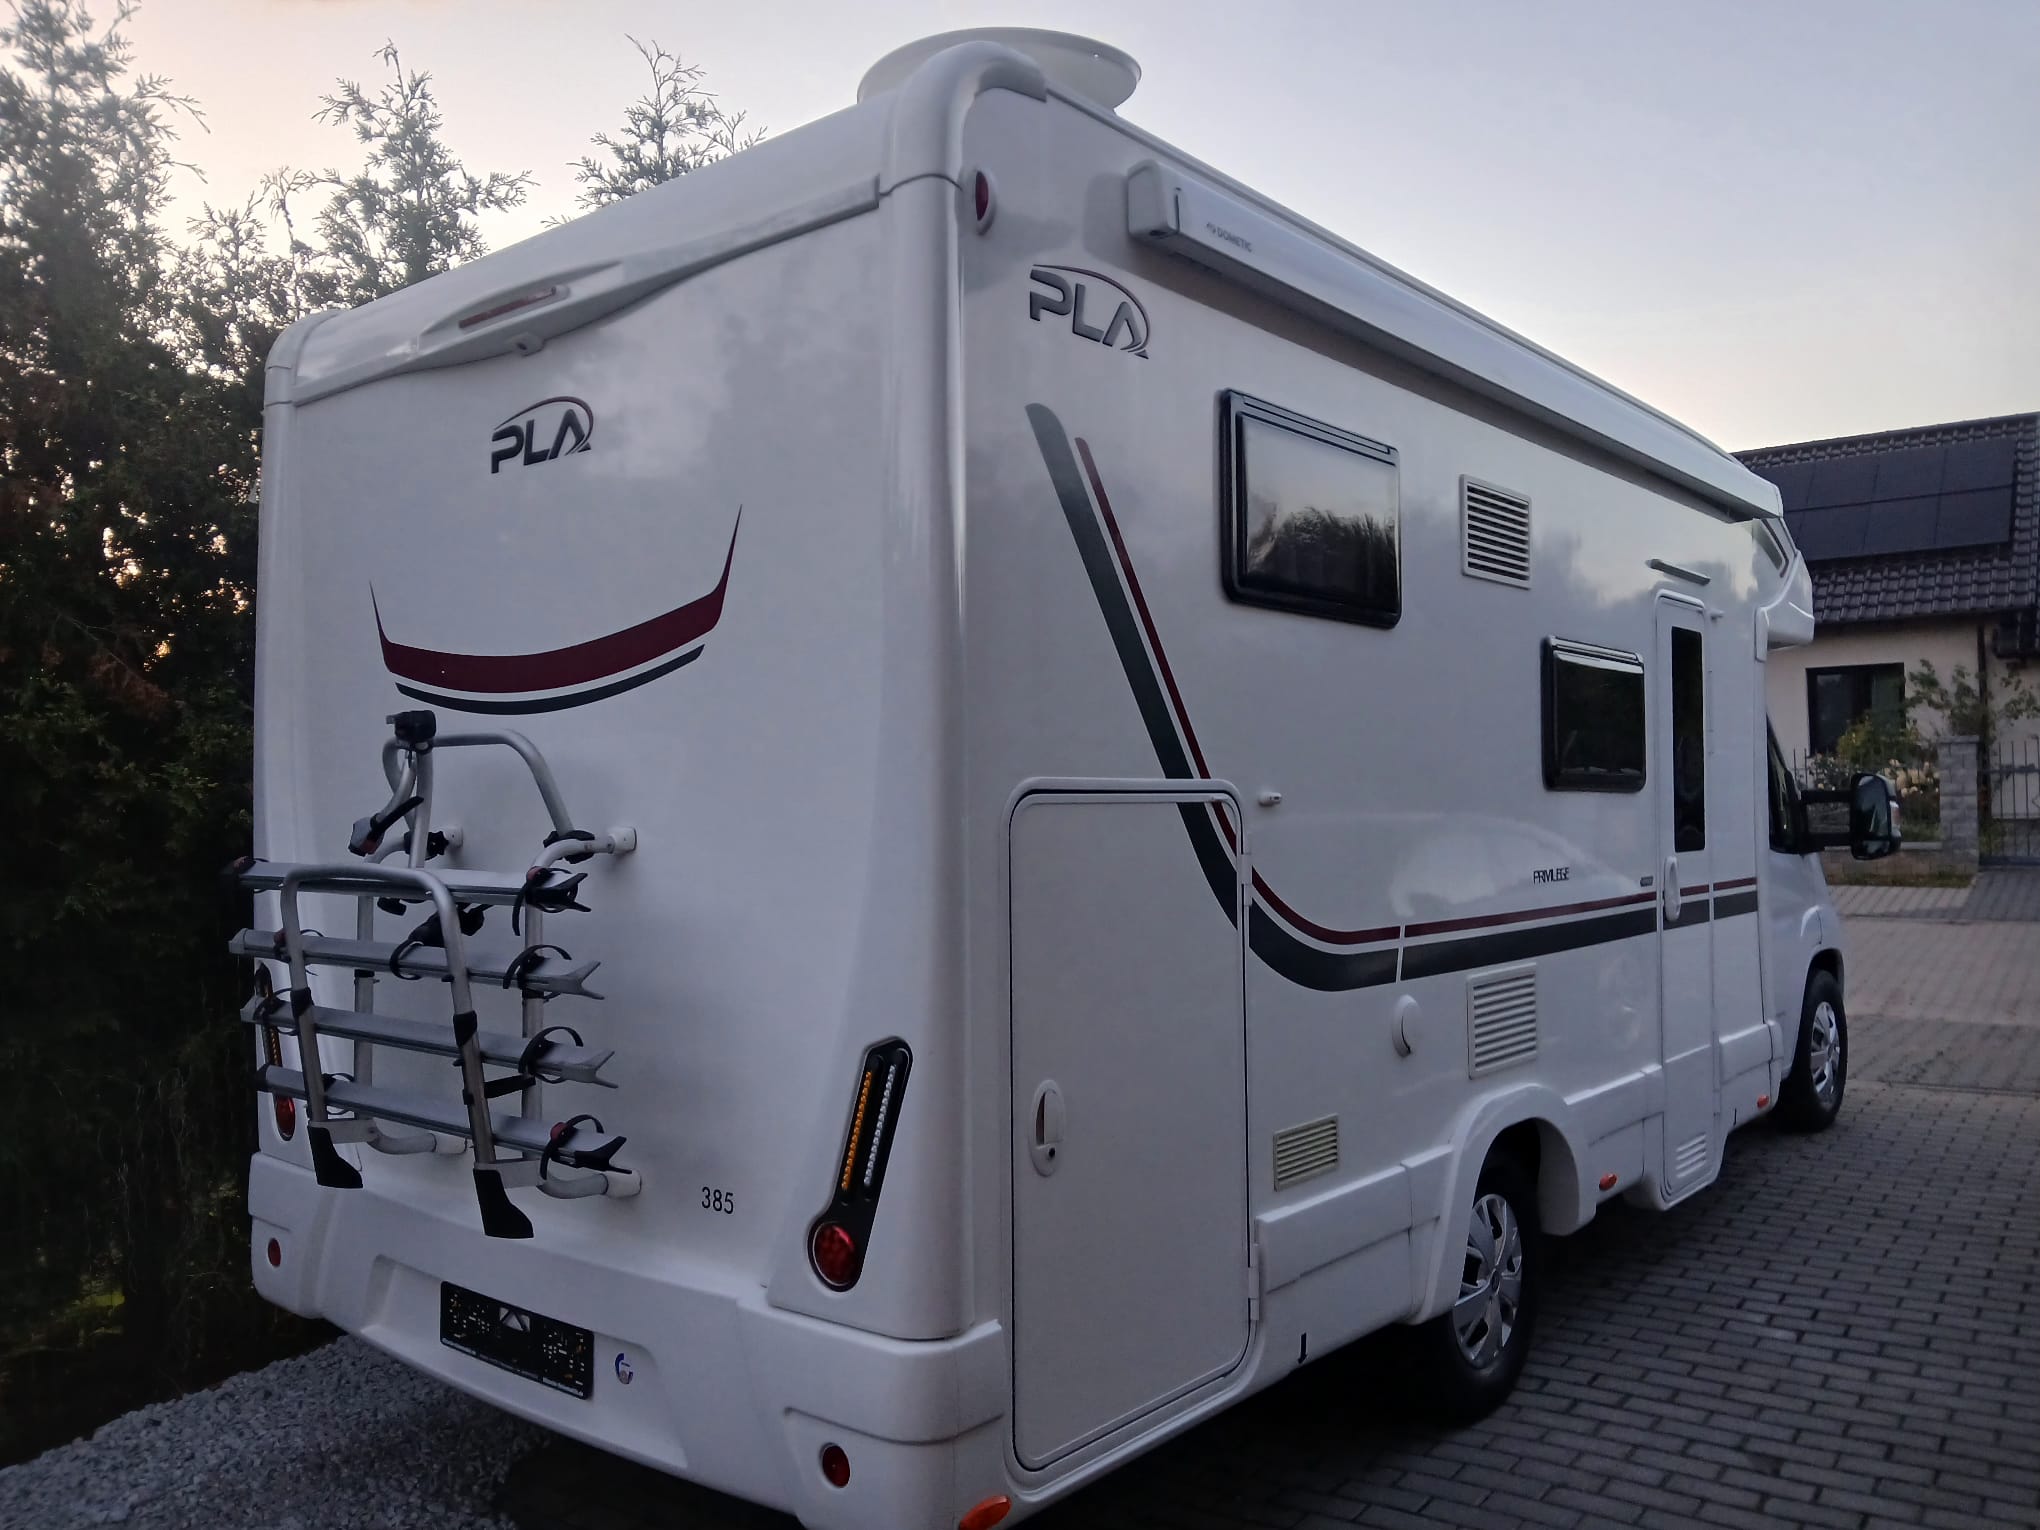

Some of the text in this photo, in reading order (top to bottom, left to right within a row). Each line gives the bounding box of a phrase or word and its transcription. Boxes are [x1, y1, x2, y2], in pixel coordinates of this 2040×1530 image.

[1029, 268, 1150, 360] PLA
[490, 407, 592, 474] PLA
[701, 1186, 734, 1215] 385
